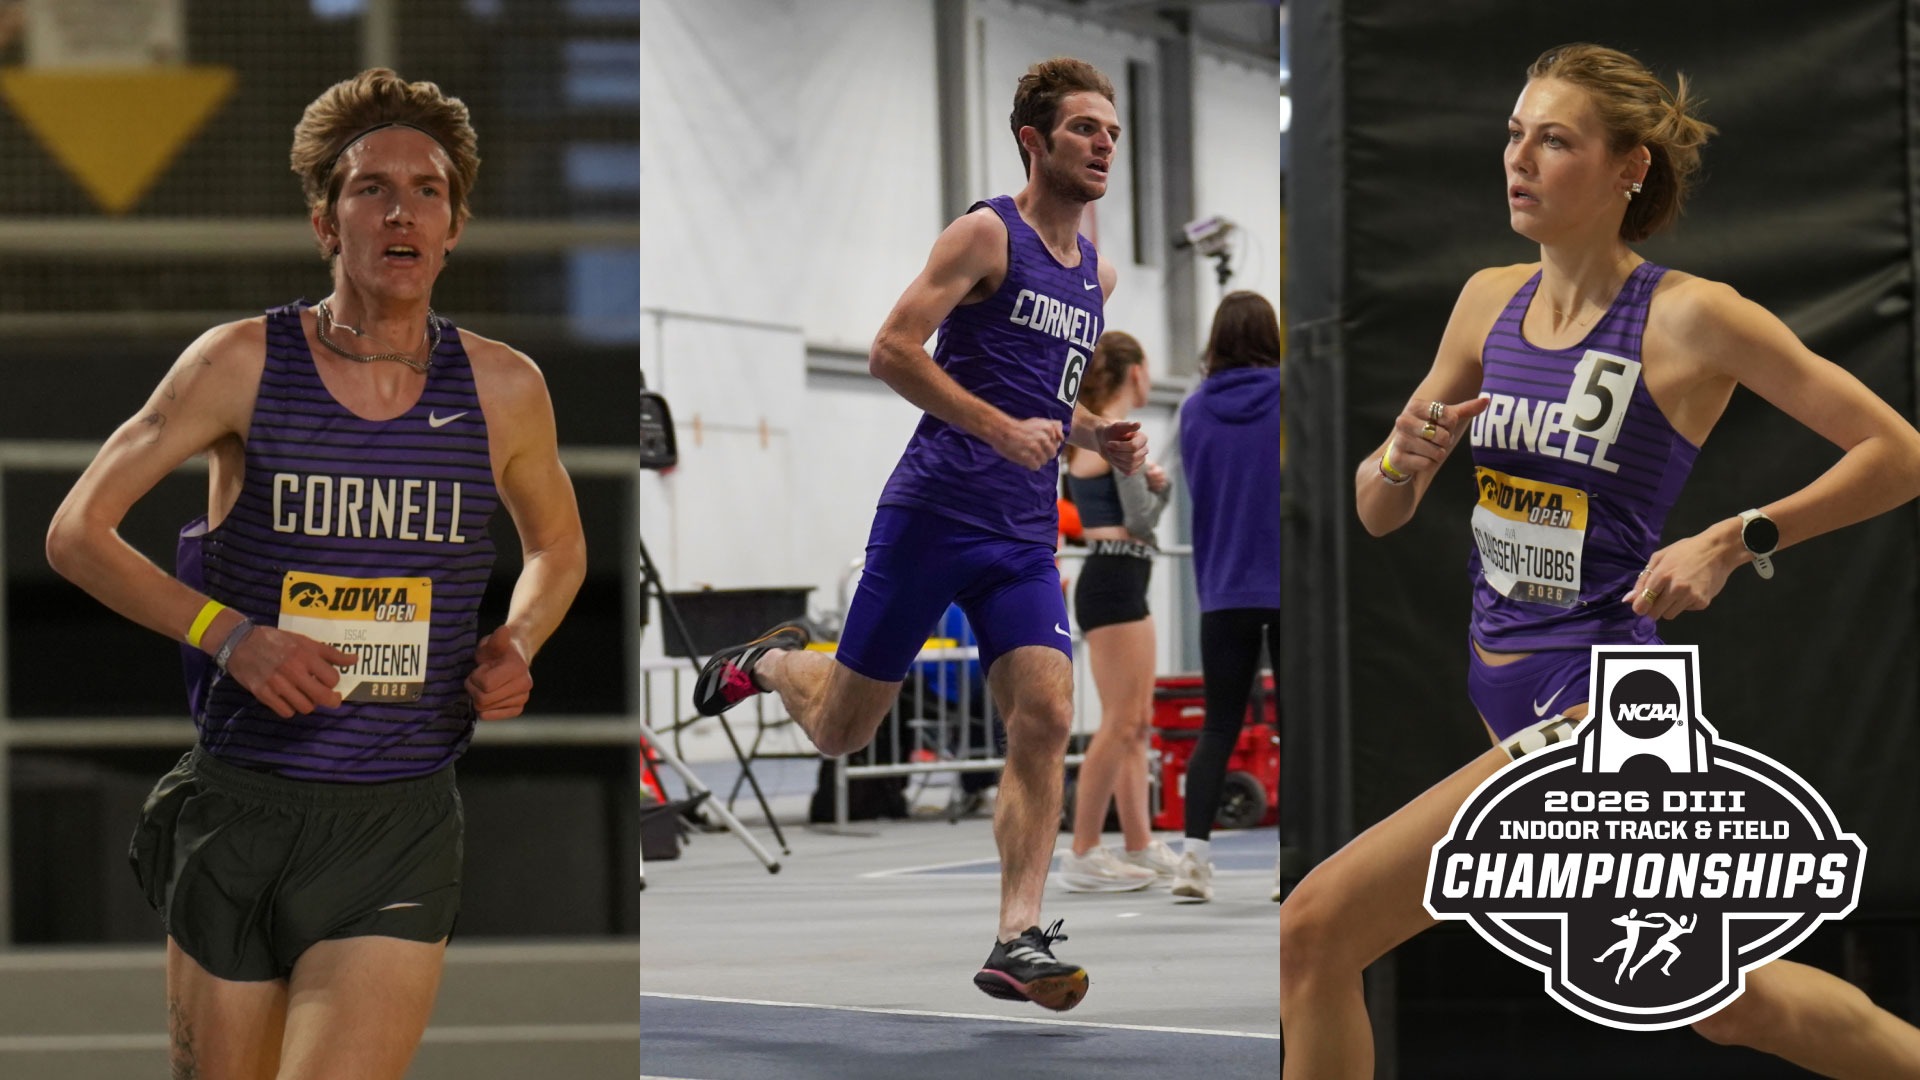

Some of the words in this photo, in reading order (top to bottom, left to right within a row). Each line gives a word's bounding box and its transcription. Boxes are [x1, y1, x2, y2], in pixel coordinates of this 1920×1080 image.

[1010, 289, 1098, 352] CORNELL
[1064, 355, 1083, 402] 6
[1572, 357, 1626, 432] 5
[1470, 391, 1620, 474] ORNELL
[273, 473, 465, 543] CORNELL
[1497, 482, 1563, 513] IOWA
[1529, 507, 1572, 527] OPEN
[328, 587, 408, 611] IOWA
[1528, 584, 1563, 600] 2026
[376, 604, 416, 621] OPEN
[344, 629, 367, 641] ISSAC
[372, 684, 407, 696] 2026
